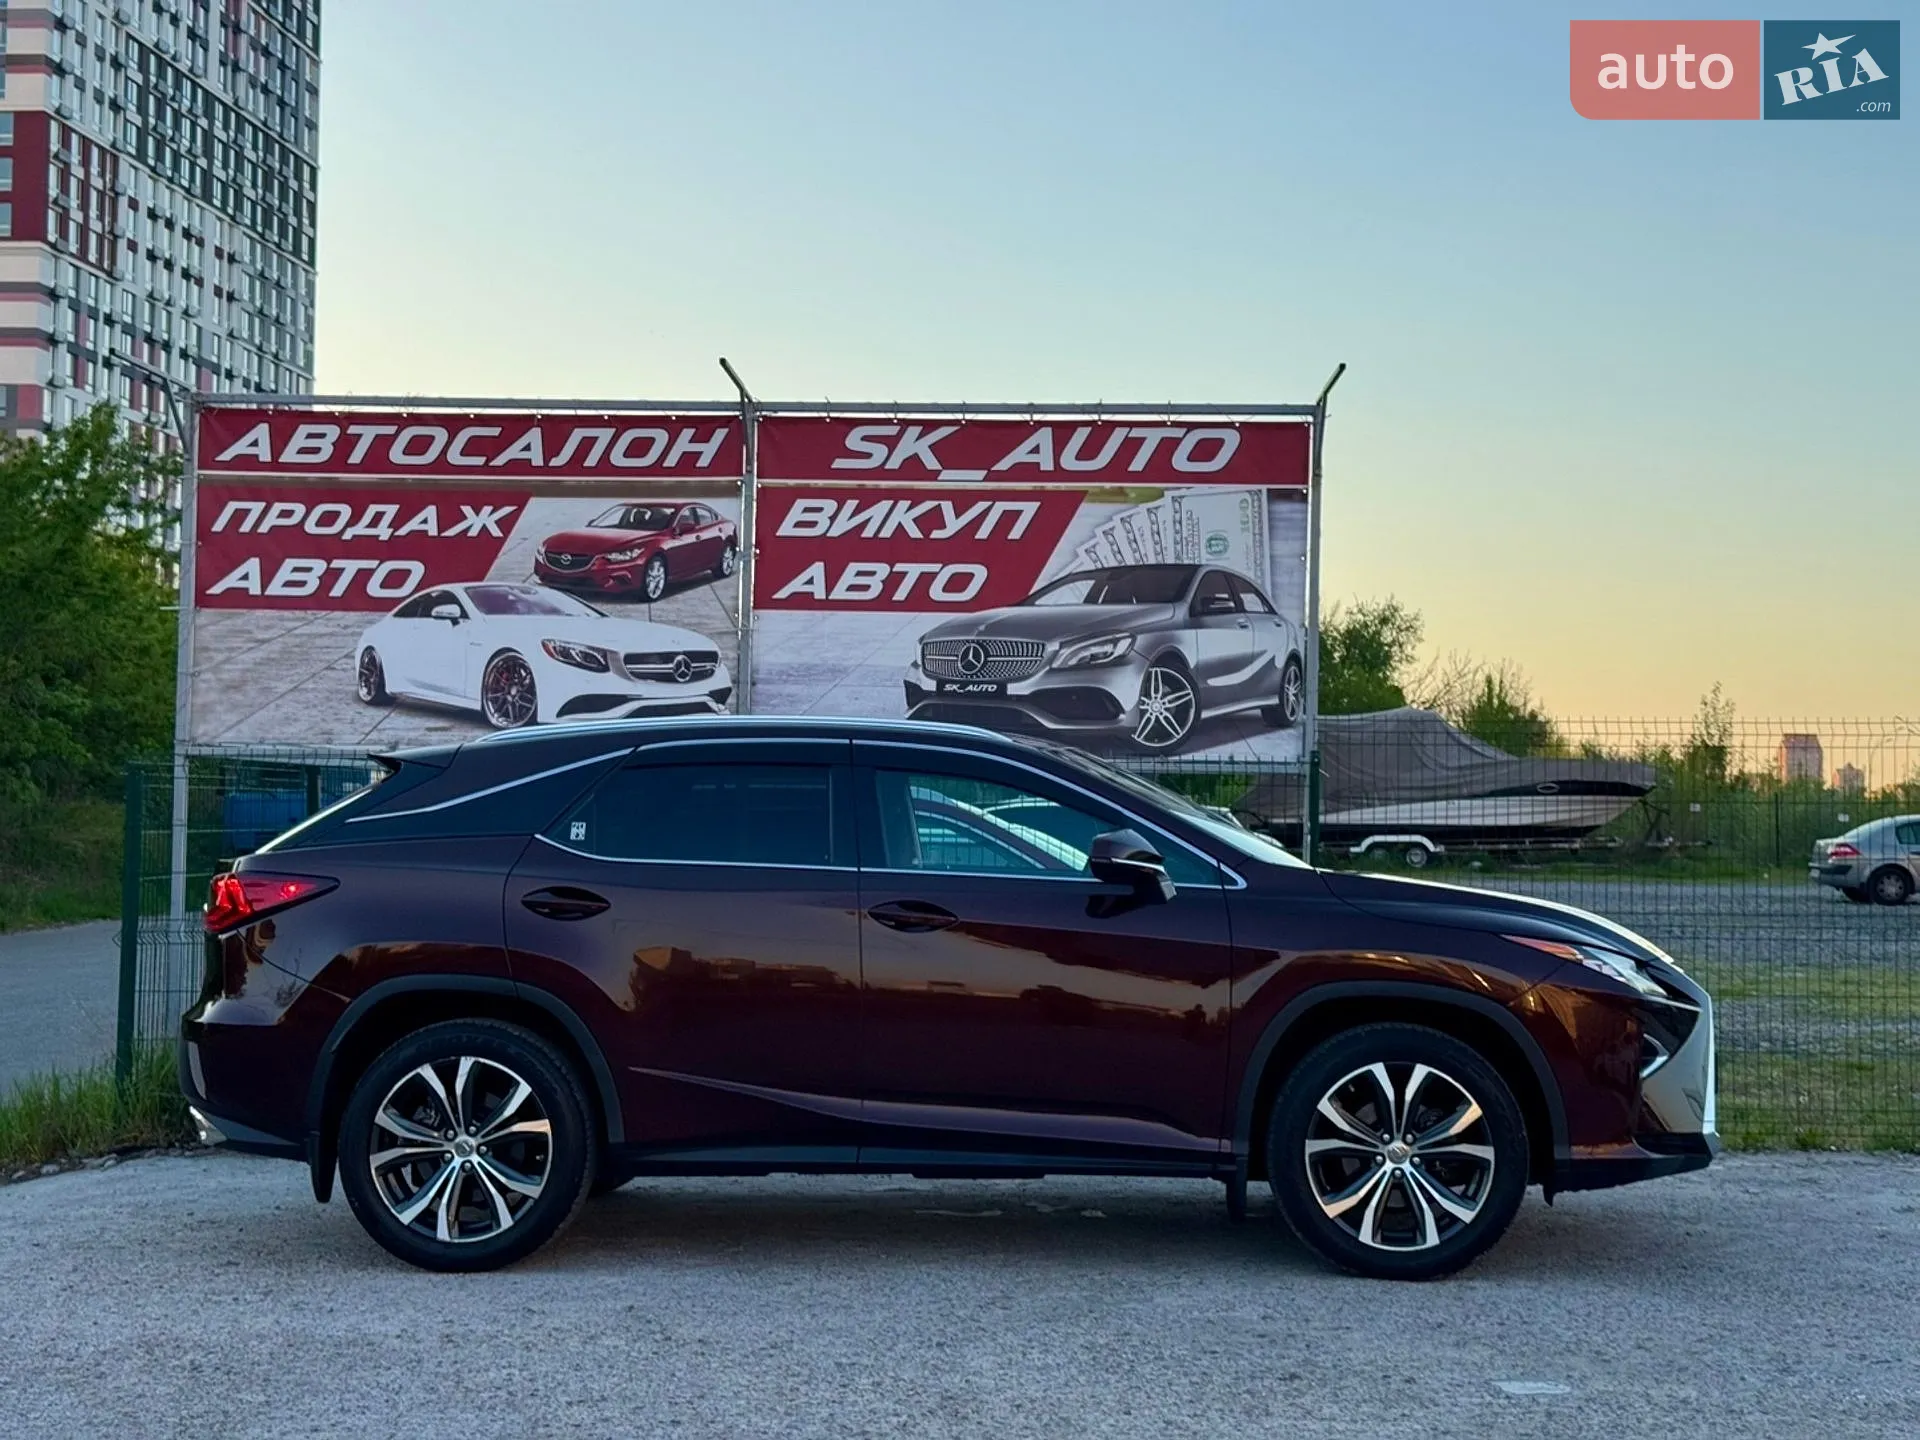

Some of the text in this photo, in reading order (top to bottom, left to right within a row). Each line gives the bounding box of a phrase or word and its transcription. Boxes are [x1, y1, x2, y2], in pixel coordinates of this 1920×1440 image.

[215, 422, 729, 468] АВТОСАЛОН
[831, 425, 1242, 481] SK_AUTO
[211, 501, 519, 540] ПРОДАЖ
[775, 497, 1040, 540] ВИКУП
[205, 557, 425, 598] АВТО
[772, 562, 988, 602] АВТО
[943, 683, 997, 693] SK_AUTO
